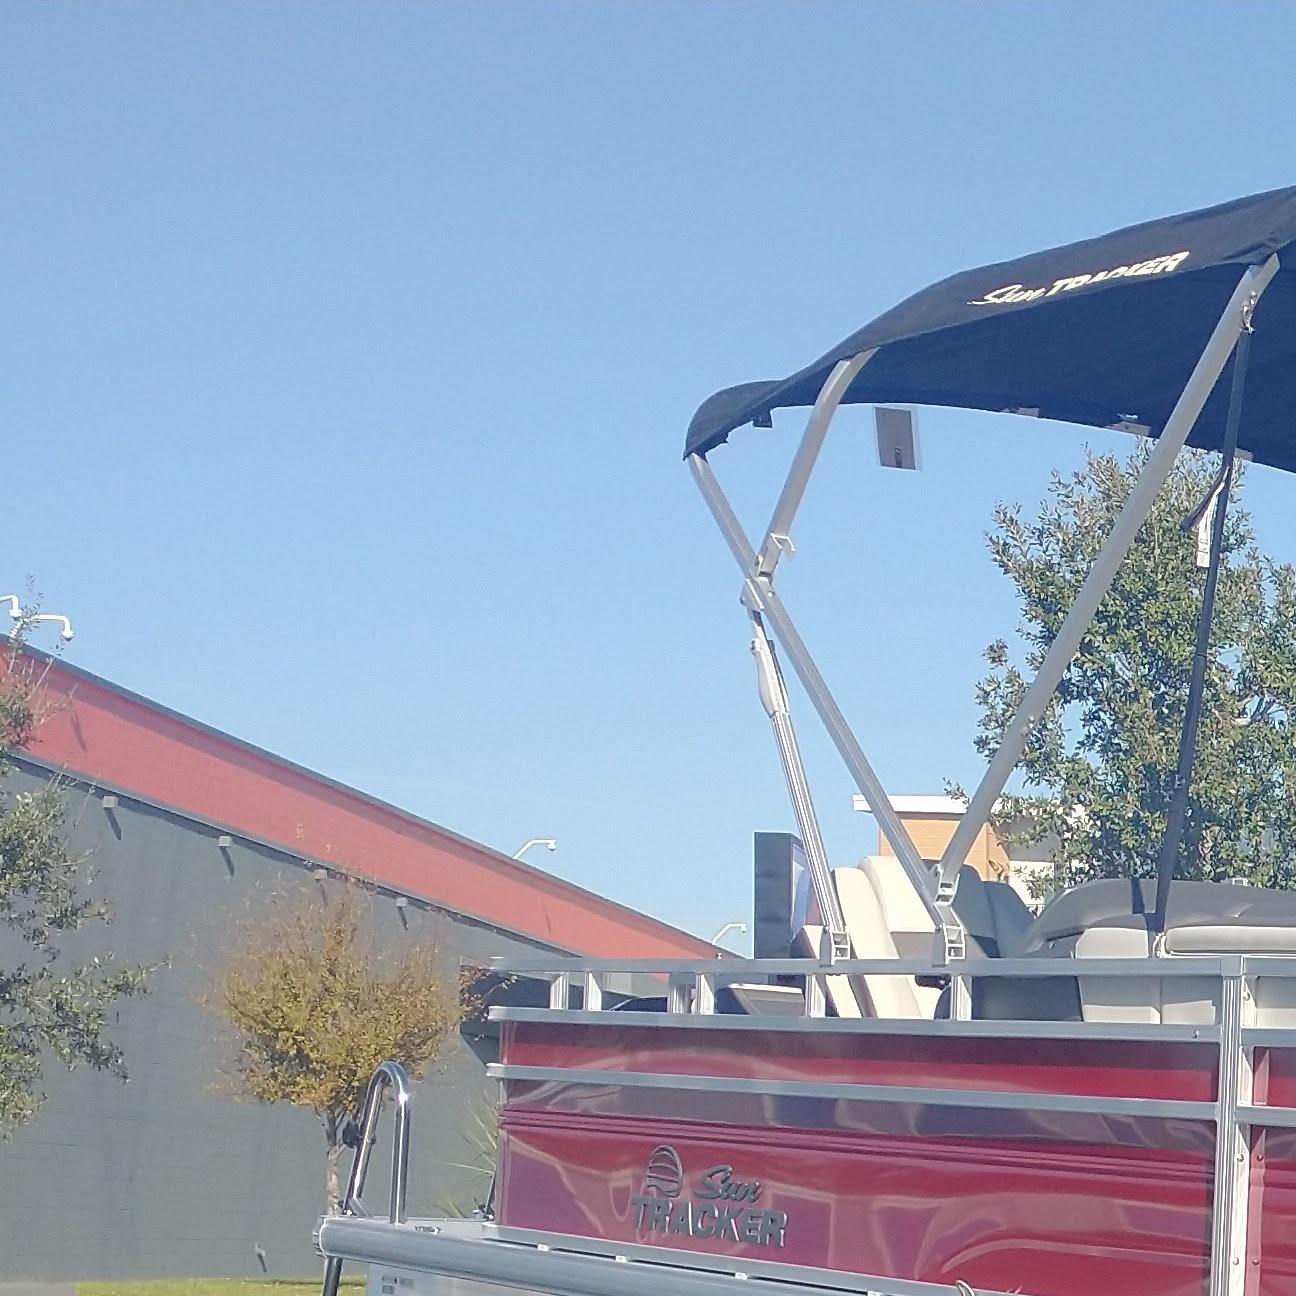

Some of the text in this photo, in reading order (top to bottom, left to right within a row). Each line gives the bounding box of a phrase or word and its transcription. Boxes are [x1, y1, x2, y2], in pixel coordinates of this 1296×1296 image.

[966, 251, 1190, 305] Sun TRACKER
[694, 1164, 763, 1203] Sun
[631, 1196, 788, 1248] TRACKER
